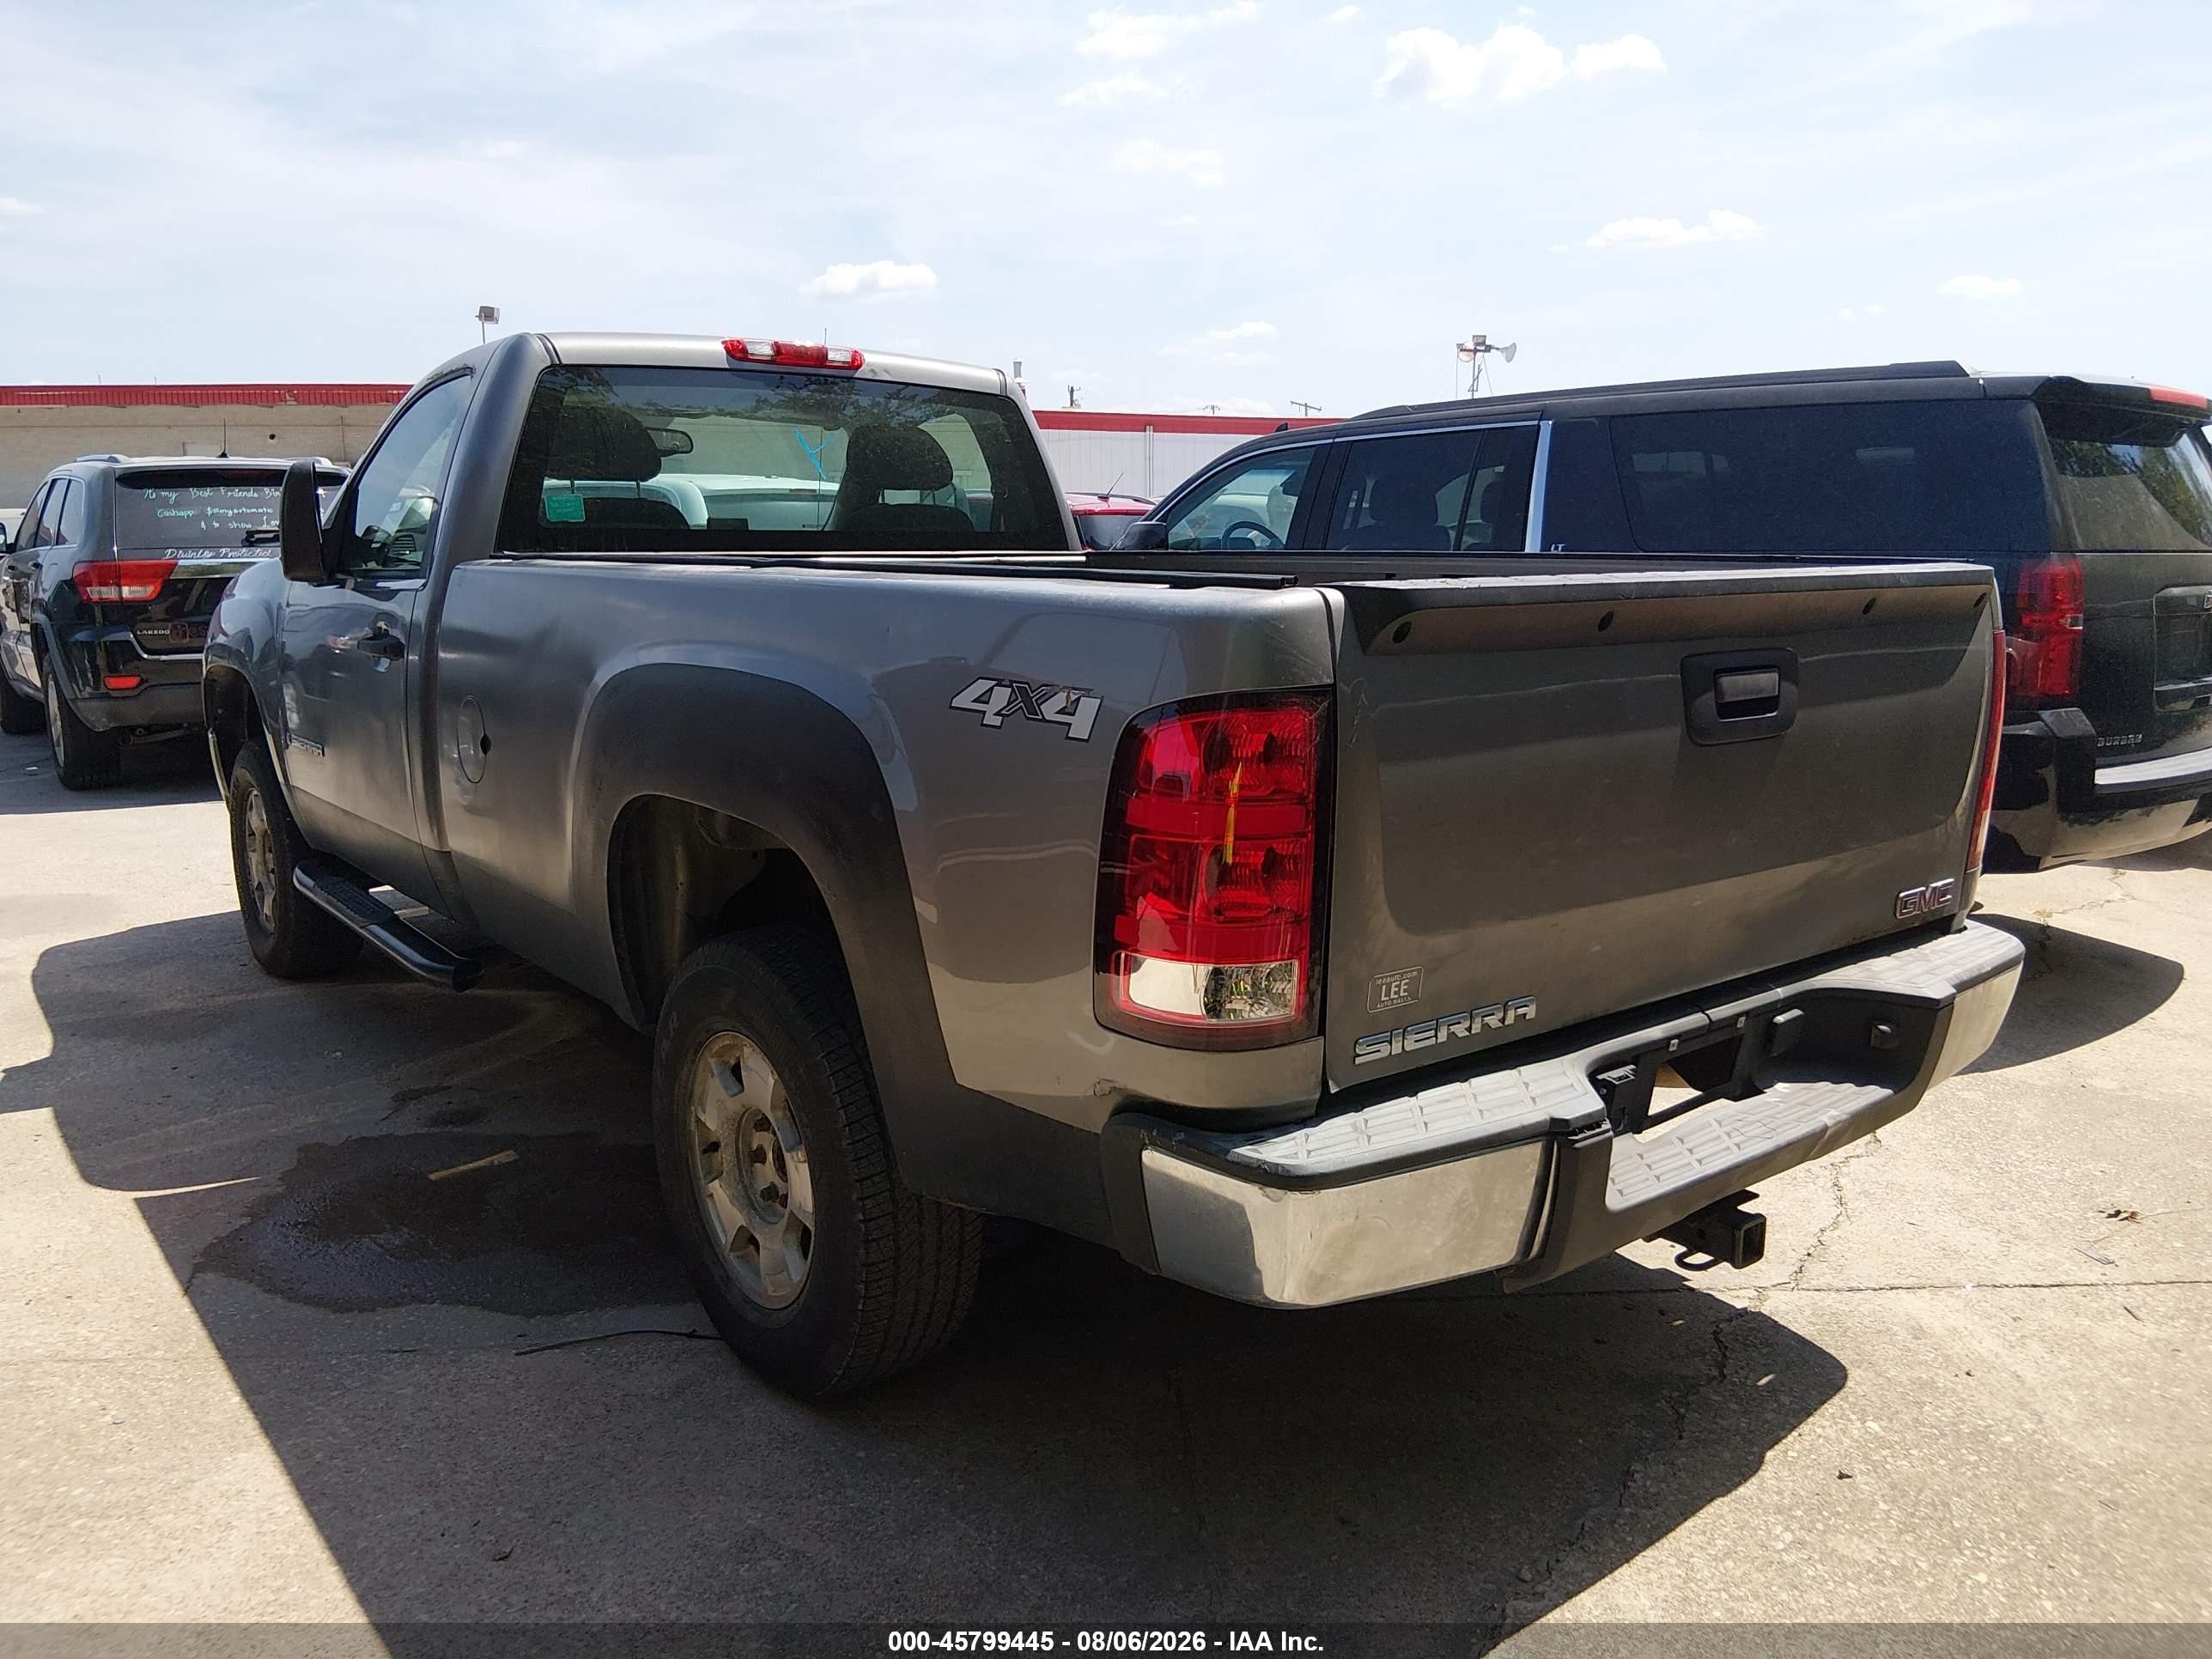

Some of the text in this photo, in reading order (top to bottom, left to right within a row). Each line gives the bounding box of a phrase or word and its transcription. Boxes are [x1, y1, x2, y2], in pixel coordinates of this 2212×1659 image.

[160, 491, 178, 505] my
[188, 488, 214, 499] Best
[212, 520, 221, 529] to
[219, 547, 272, 559] Protected
[1895, 878, 1955, 919] GMC
[1381, 979, 1410, 1001] LEE
[1376, 1000, 1392, 1009] AUTO
[1353, 995, 1537, 1066] SIERRA
